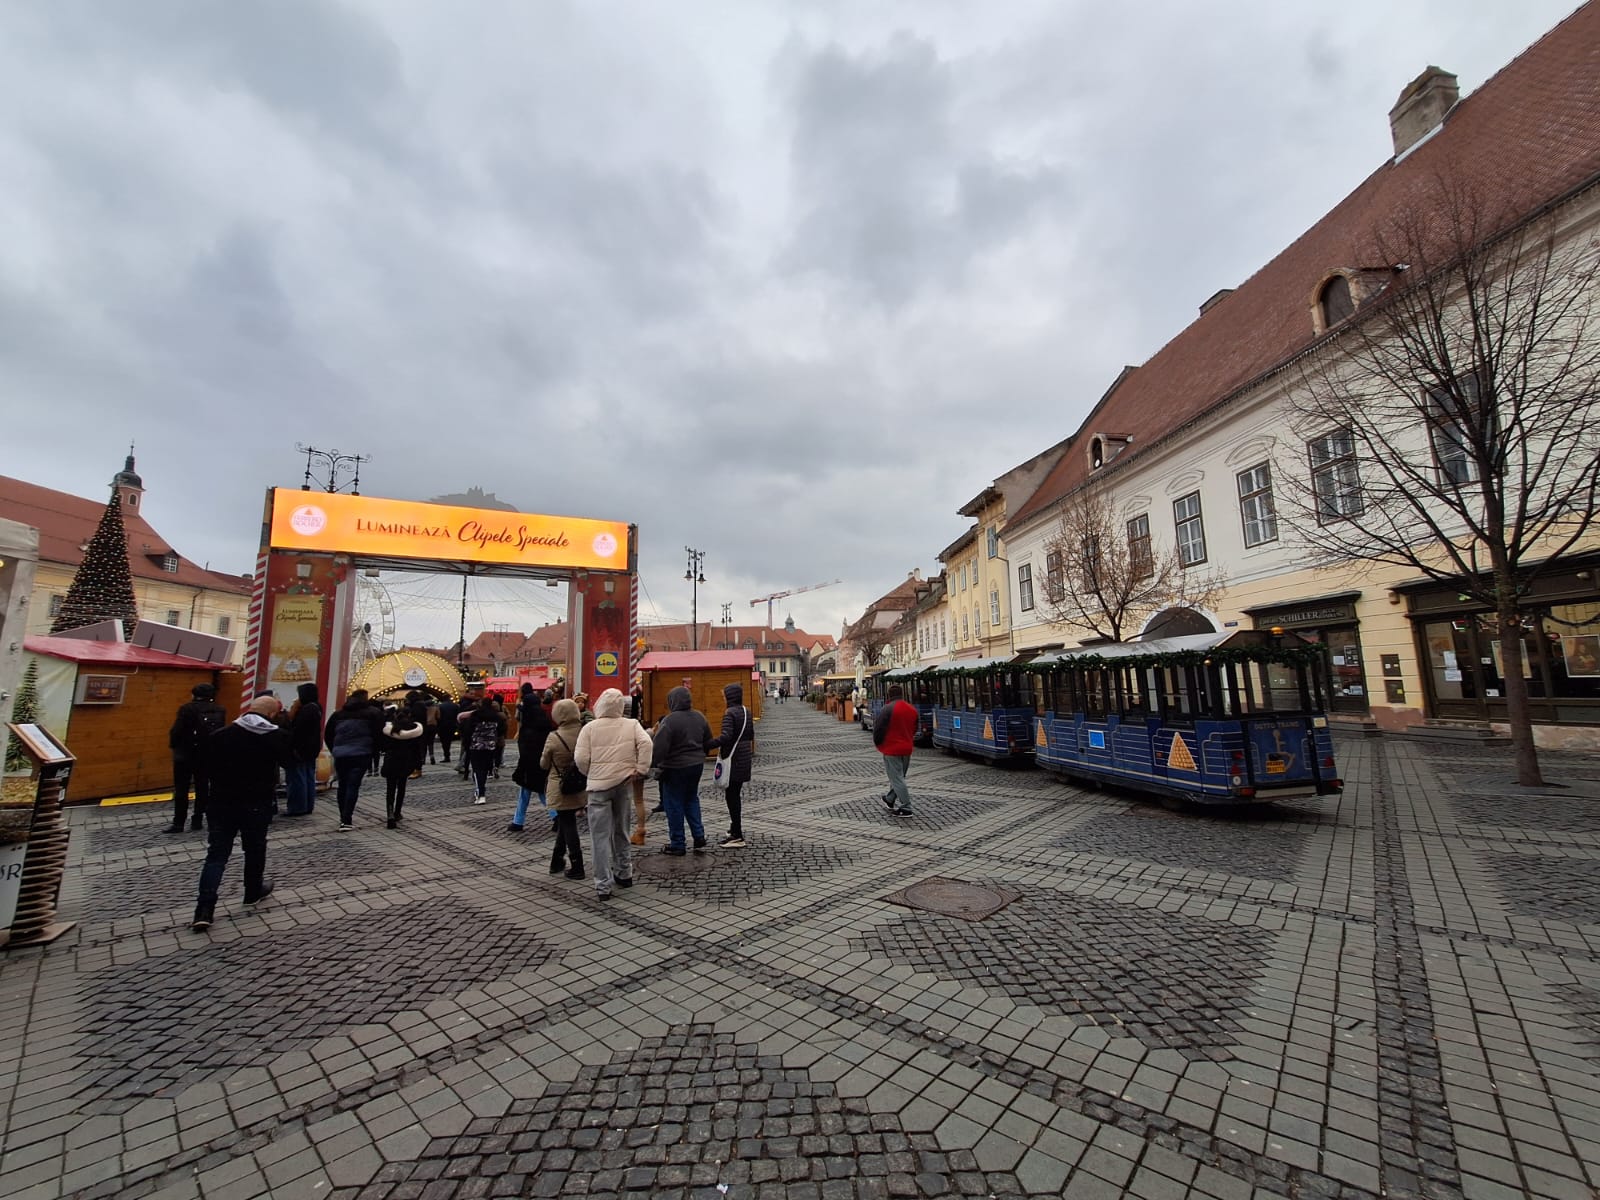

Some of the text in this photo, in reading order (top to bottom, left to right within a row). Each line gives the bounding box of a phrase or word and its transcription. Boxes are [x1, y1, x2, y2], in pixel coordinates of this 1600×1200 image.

[357, 518, 570, 551] LUMINEAZĂ Clipele Speciale
[1279, 611, 1318, 623] SCHILLER
